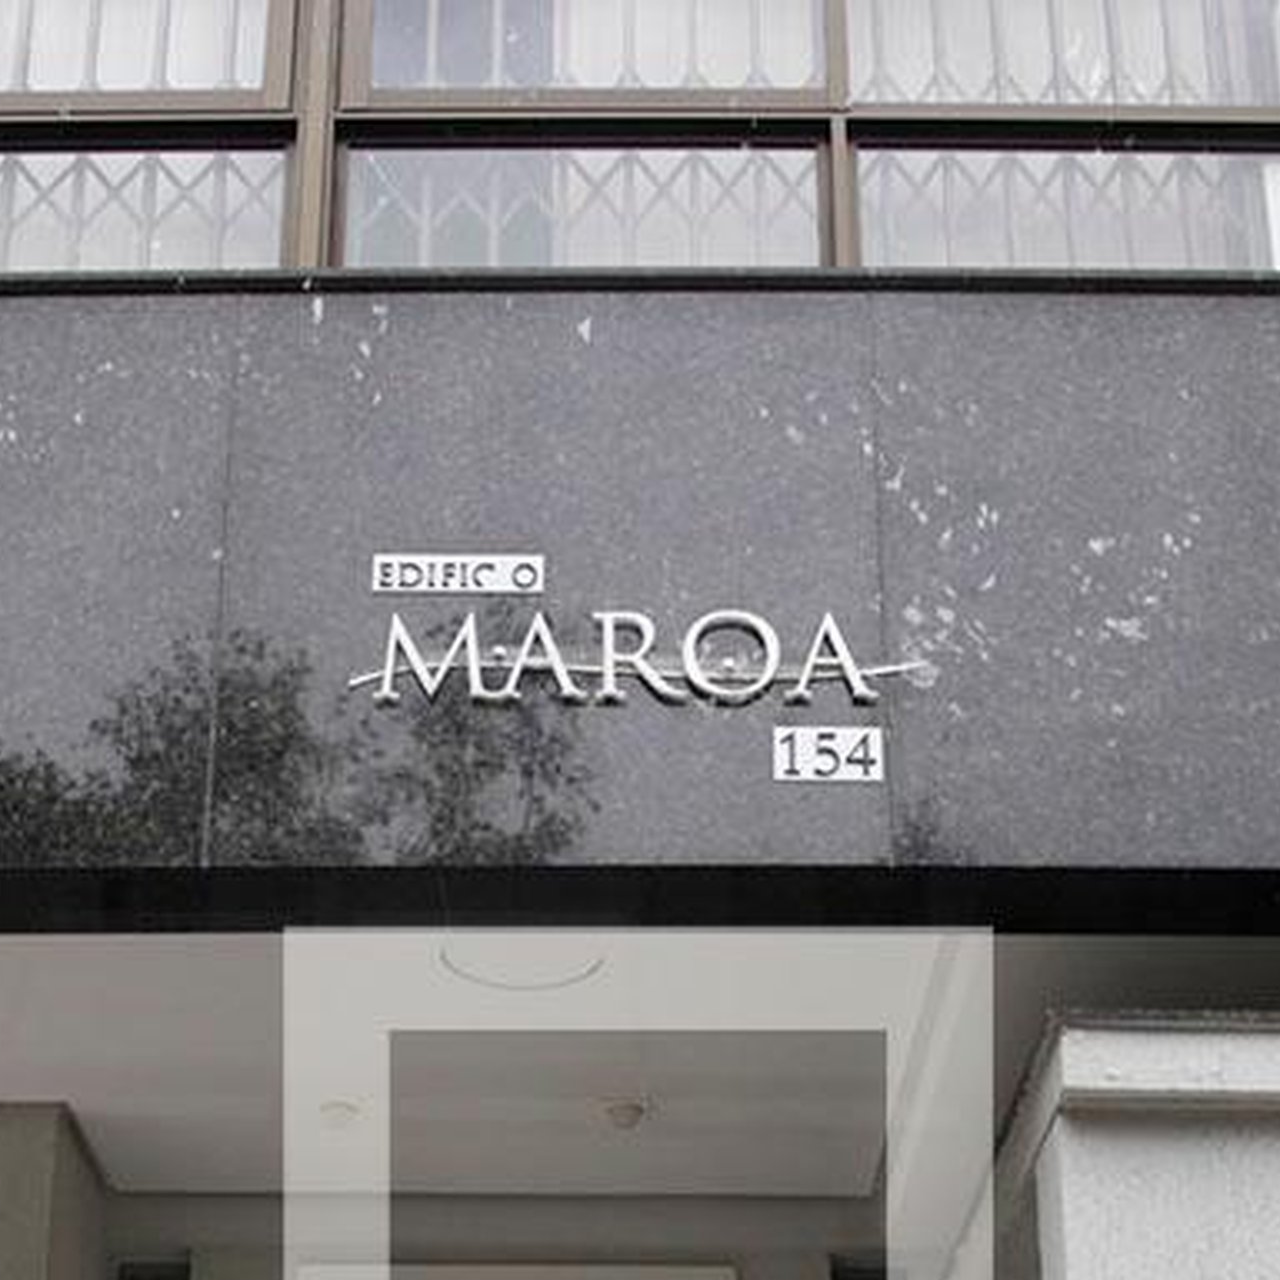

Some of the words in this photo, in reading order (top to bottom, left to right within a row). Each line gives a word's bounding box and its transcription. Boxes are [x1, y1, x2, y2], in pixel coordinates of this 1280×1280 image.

[379, 562, 538, 589] EDIFICO
[372, 609, 881, 700] MAROA
[780, 731, 877, 777] 154
